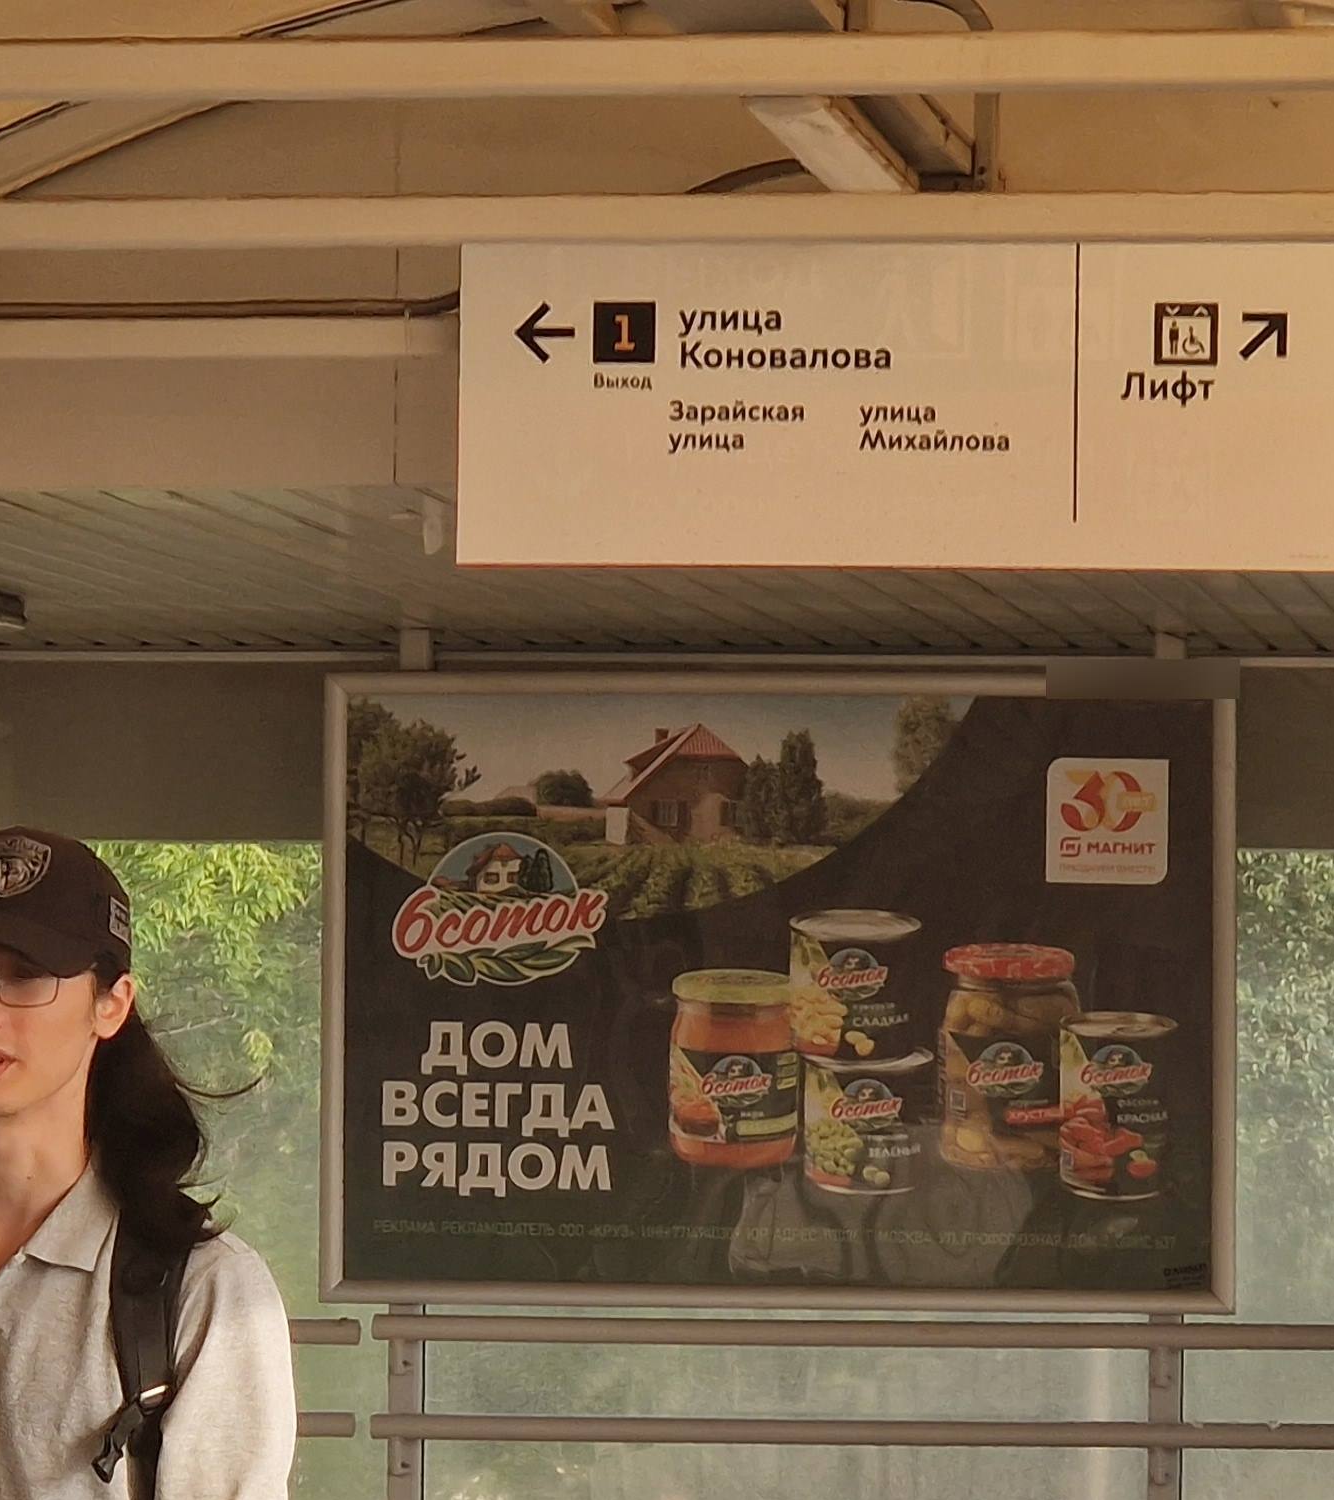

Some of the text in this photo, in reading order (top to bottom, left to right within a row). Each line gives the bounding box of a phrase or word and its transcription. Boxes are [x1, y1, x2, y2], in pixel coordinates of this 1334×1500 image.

[613, 314, 636, 351] 1
[679, 309, 782, 337] улица
[680, 341, 892, 370] Коновалова
[593, 374, 652, 391] Выход
[1121, 372, 1216, 405] Лифт
[669, 401, 805, 426] Зарайская
[859, 404, 937, 427] улица
[668, 432, 745, 455] улица
[859, 430, 1010, 452] Михайлова
[1087, 842, 1156, 854] МАГНИТ
[421, 1021, 573, 1075] ДОМ
[381, 1081, 616, 1137] ВСЕГДА
[382, 1141, 612, 1197] РЯДОМ
